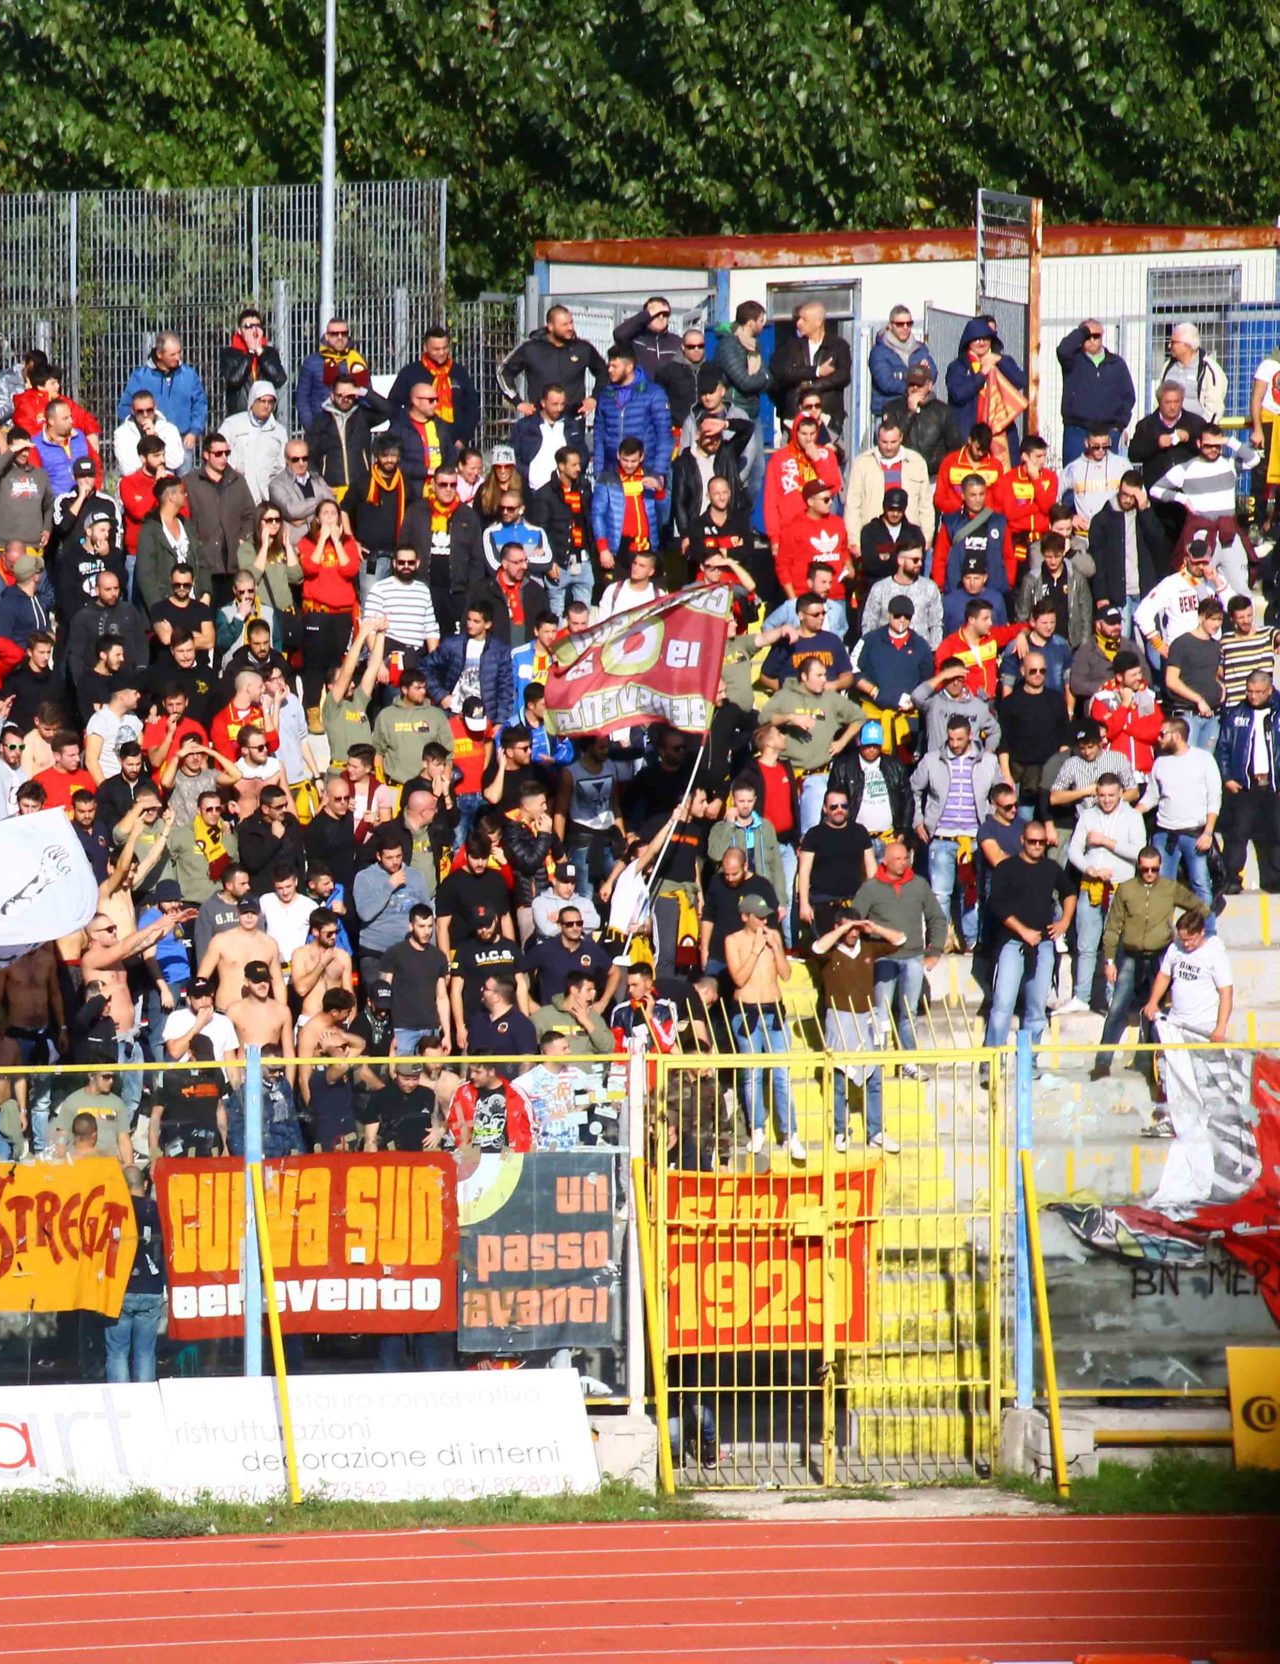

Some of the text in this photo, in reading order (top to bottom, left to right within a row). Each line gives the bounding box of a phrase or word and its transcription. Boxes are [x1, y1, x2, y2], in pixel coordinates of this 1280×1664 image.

[556, 1175, 609, 1214] un
[345, 1165, 444, 1267] SUD
[477, 1230, 609, 1283] passo
[669, 1257, 853, 1331] 1929
[1131, 1259, 1280, 1299] BN MER
[463, 1286, 609, 1328] avanti
[174, 1416, 372, 1445] ristruttuazioni
[437, 1443, 463, 1467] di
[471, 1440, 561, 1465] interni
